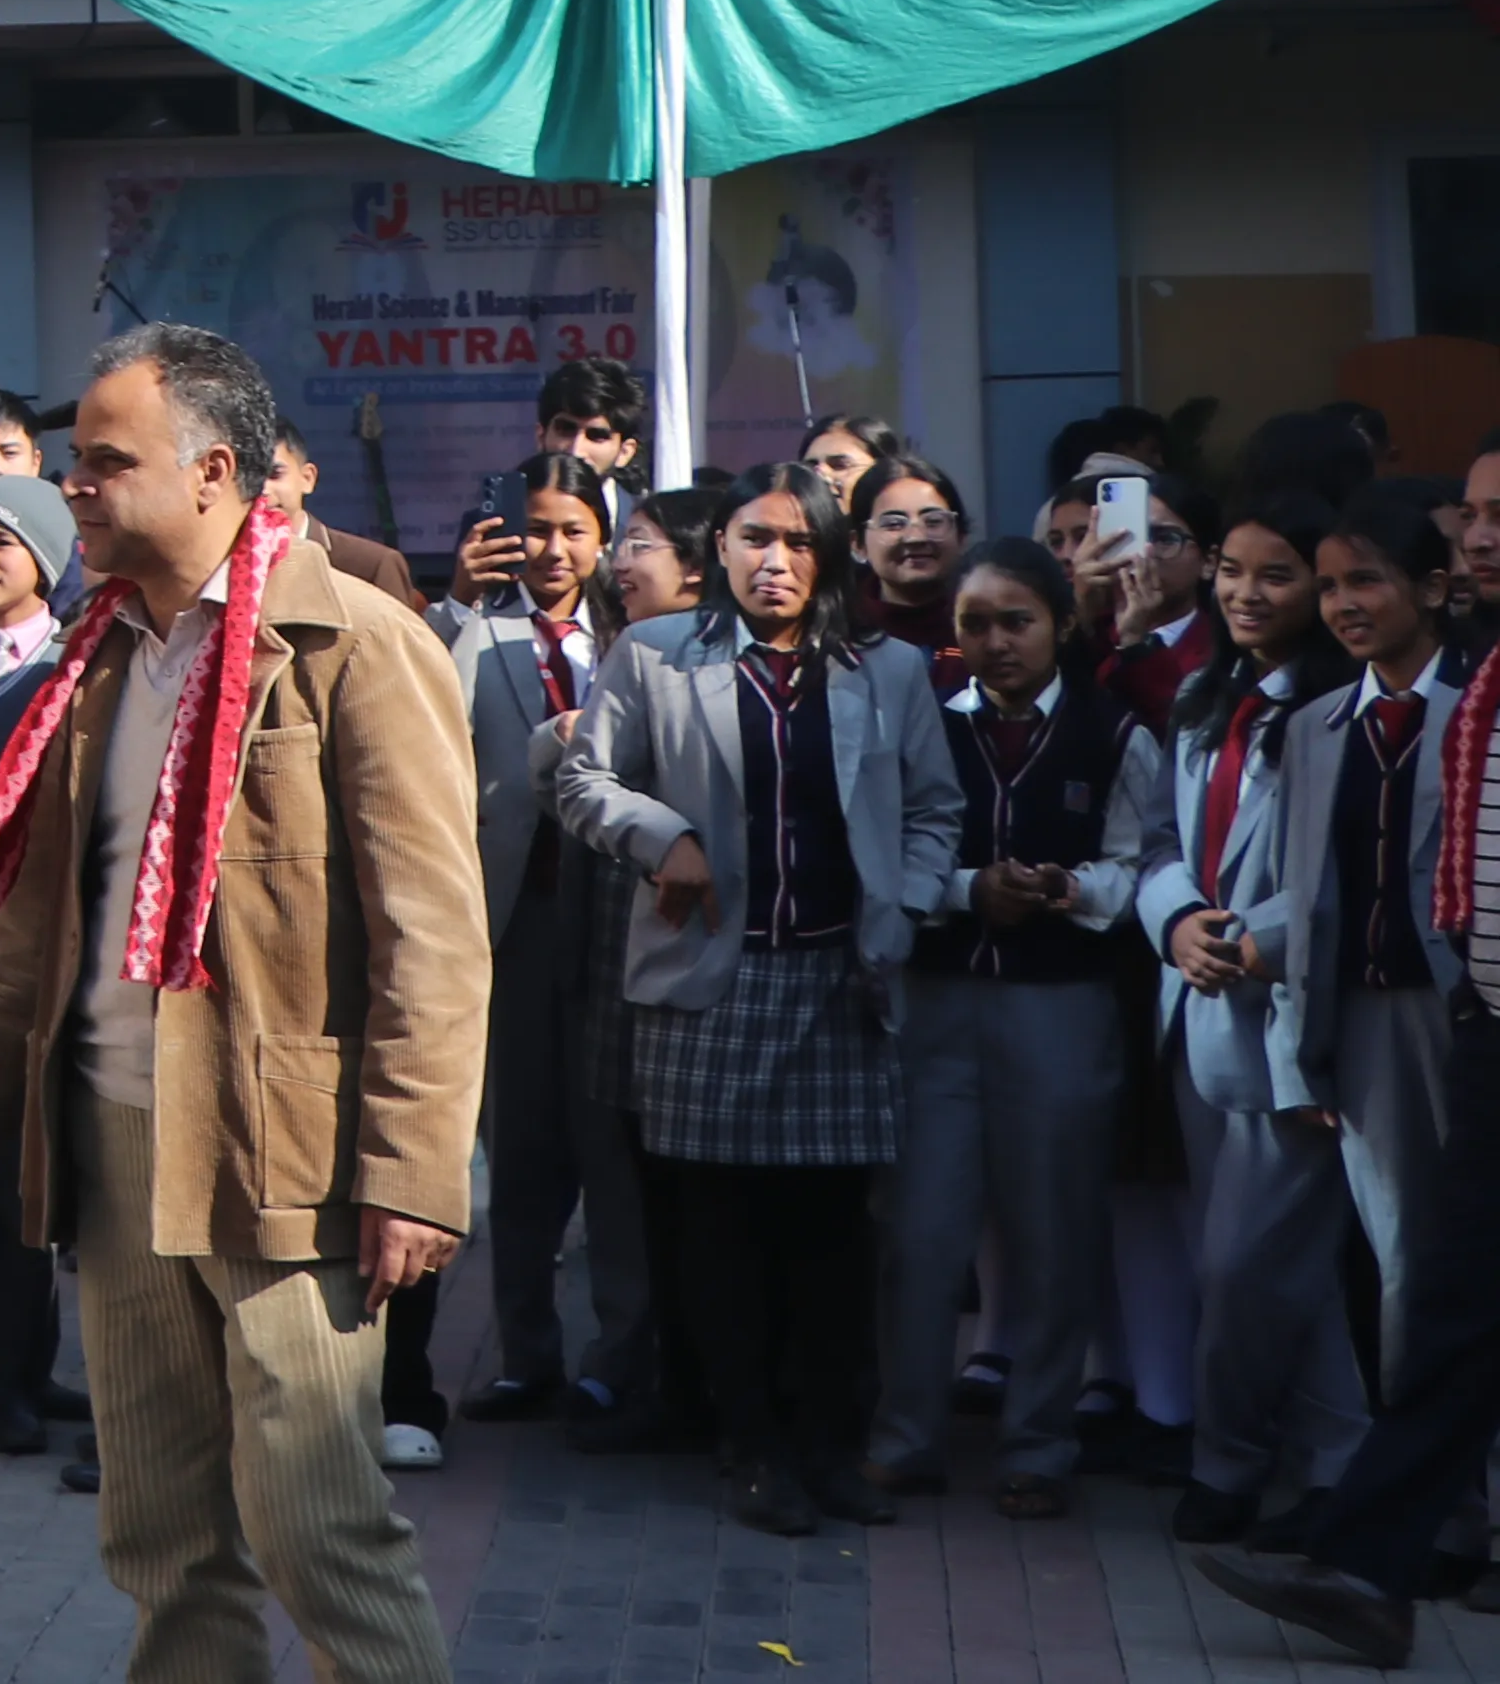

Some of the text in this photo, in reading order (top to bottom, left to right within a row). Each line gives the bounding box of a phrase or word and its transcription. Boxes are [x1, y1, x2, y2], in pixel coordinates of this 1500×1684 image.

[442, 182, 600, 218] HERALD
[312, 292, 373, 320] Herald
[377, 291, 450, 319] Science
[316, 323, 637, 368] YANTRA 3.0
